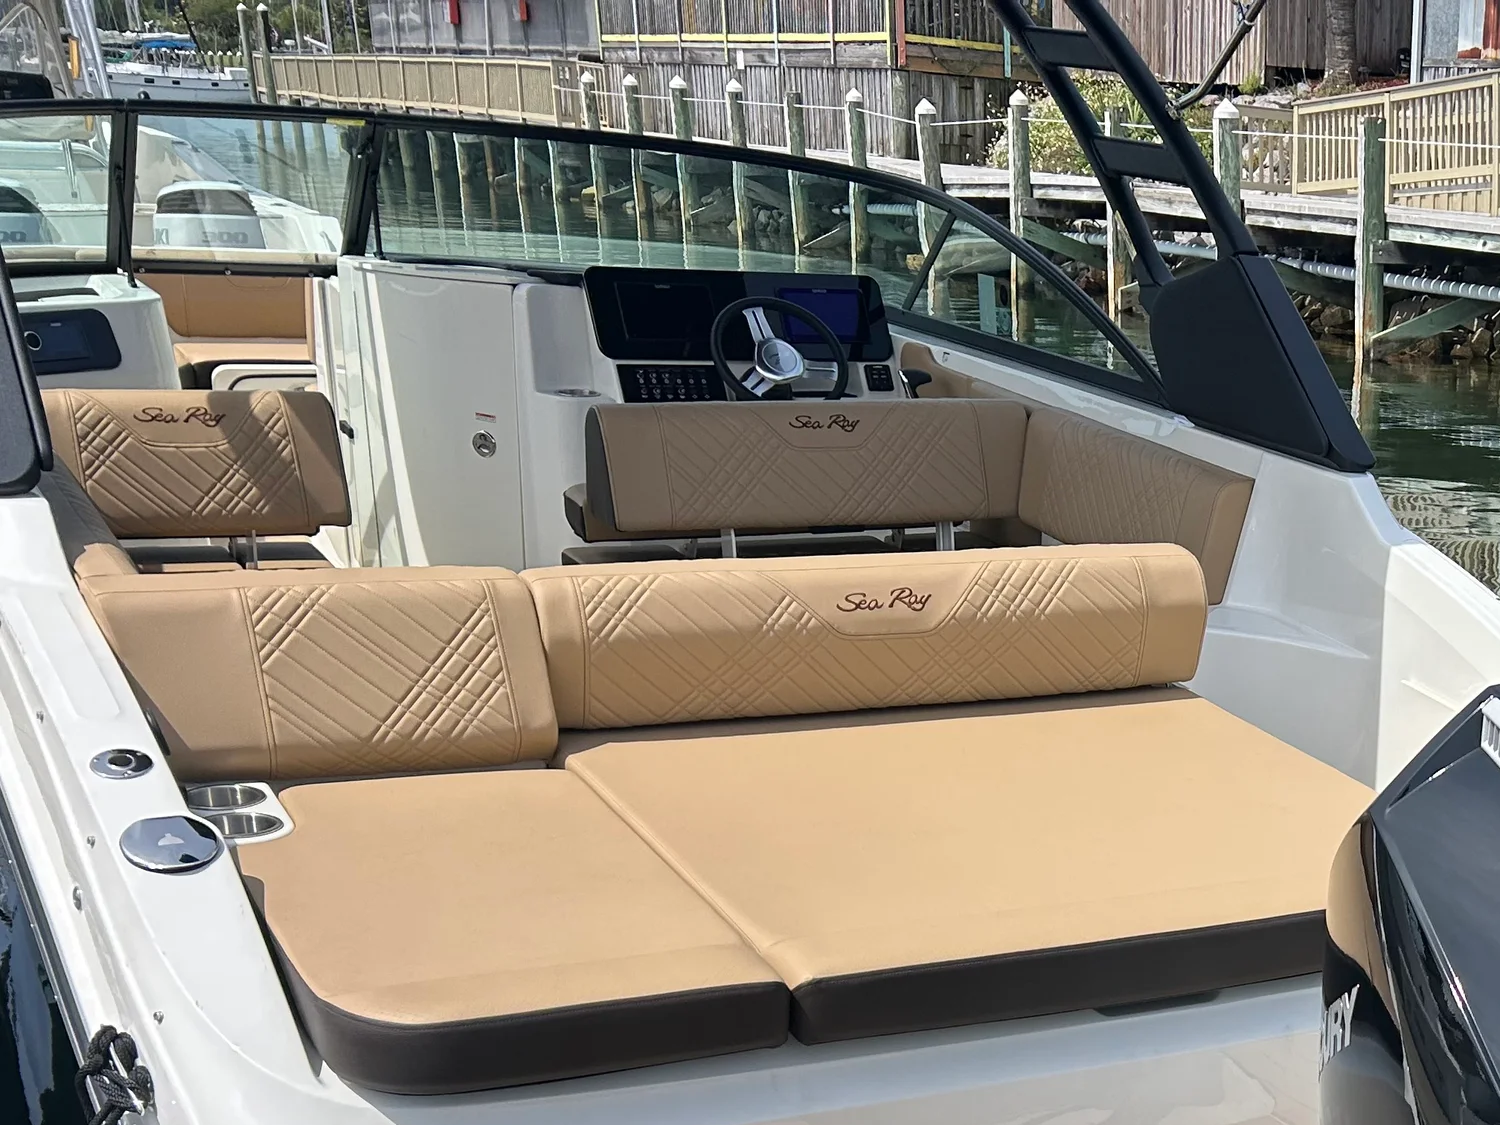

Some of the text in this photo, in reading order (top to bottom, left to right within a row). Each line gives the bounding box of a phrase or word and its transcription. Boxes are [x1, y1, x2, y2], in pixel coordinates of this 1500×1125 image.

[133, 406, 226, 428] Sea Ray
[788, 413, 860, 433] Sea Ray
[836, 587, 932, 612] Sea Ray
[1319, 983, 1360, 1072] URY
